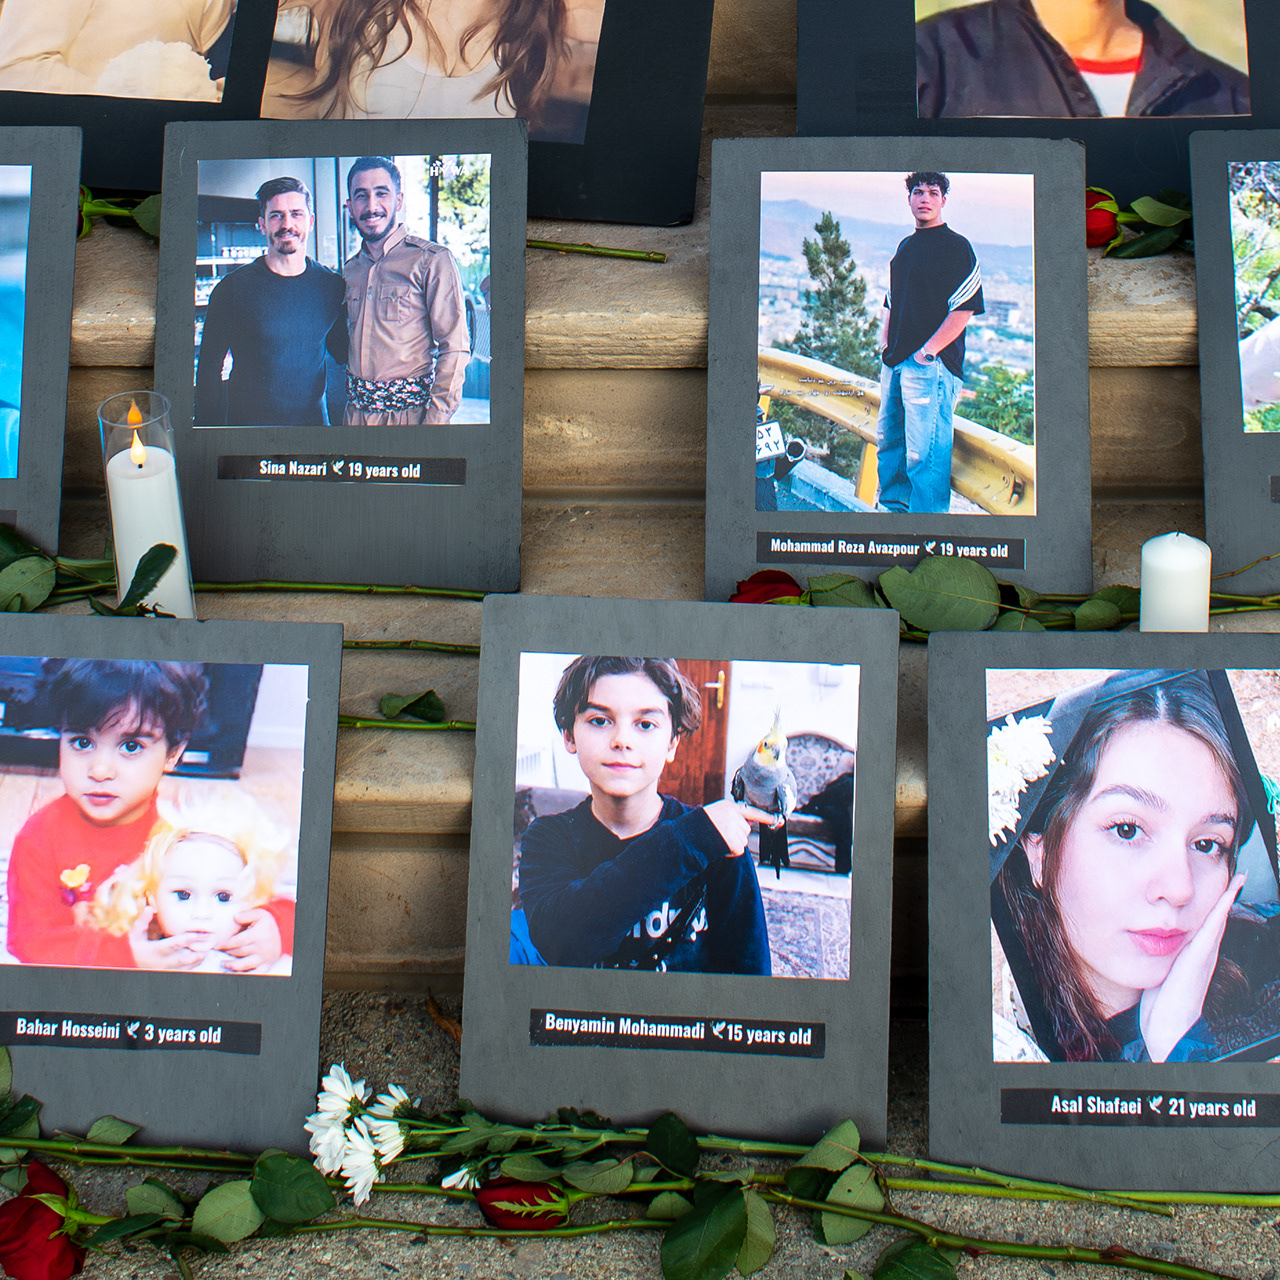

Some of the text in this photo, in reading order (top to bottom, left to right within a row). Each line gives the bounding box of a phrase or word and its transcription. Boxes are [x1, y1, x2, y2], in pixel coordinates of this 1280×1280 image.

[259, 460, 421, 480] Sina Nazari 19 years old
[770, 538, 1008, 558] Mohammad Reza Avazpour 19 years old
[16, 1017, 222, 1044] Bahar Hosseini 3 years old
[545, 1013, 812, 1046] Benyamin Mohammadi 15 years old
[1051, 1095, 1257, 1119] Asal Shafaei 21 years old
